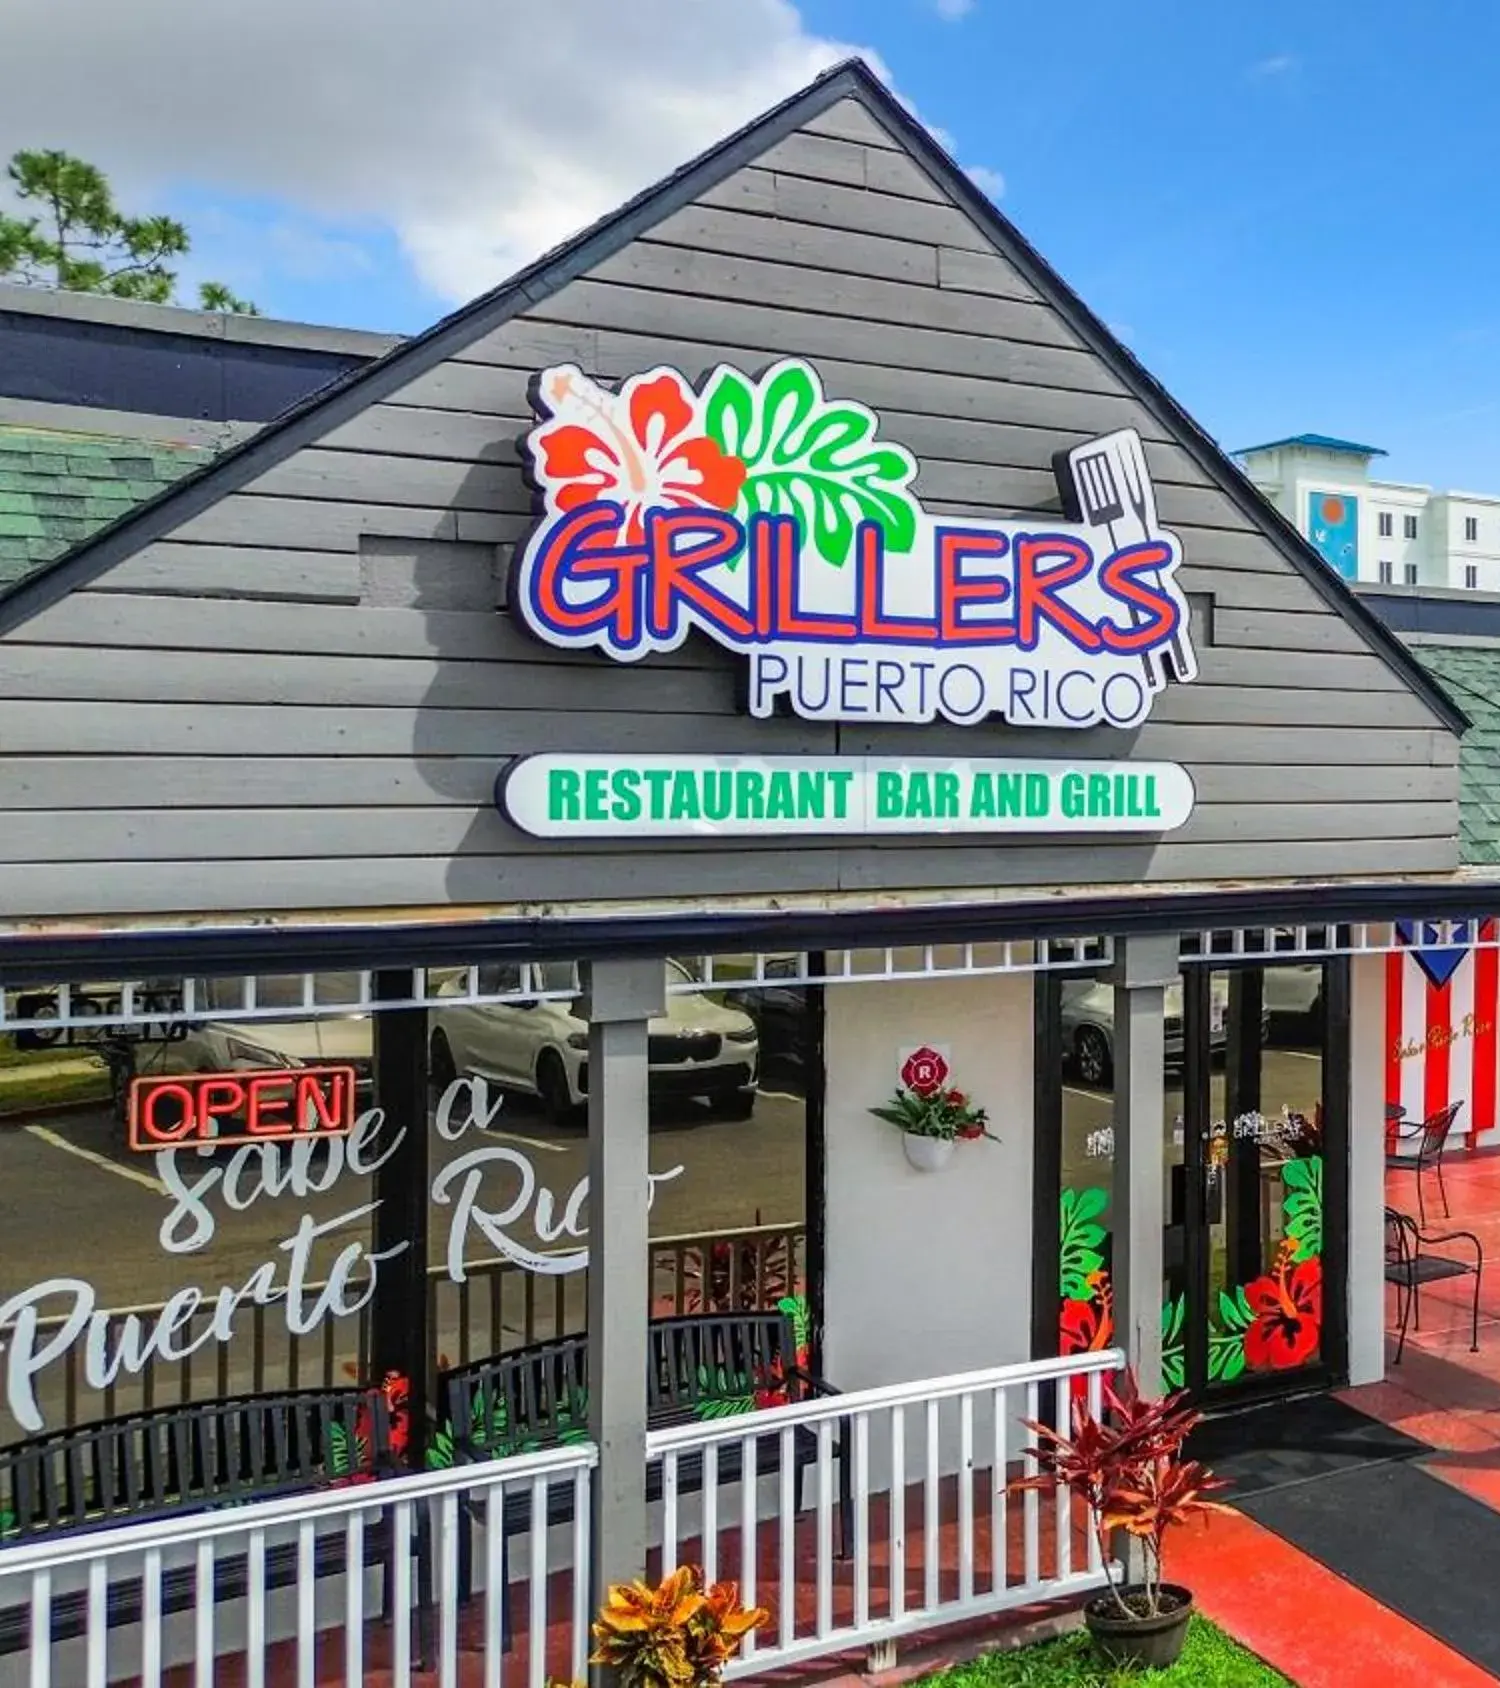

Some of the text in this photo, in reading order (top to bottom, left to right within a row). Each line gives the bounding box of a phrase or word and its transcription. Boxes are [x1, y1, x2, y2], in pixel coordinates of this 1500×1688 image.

[530, 500, 1180, 655] GRILLERS
[757, 654, 1143, 723] PUERTO RICO
[548, 769, 1162, 821] RESTAURANT BAR AND GRILL
[145, 1074, 343, 1141] OPEN
[435, 1075, 504, 1141] a
[0, 1147, 685, 1432] Puerto Ric
